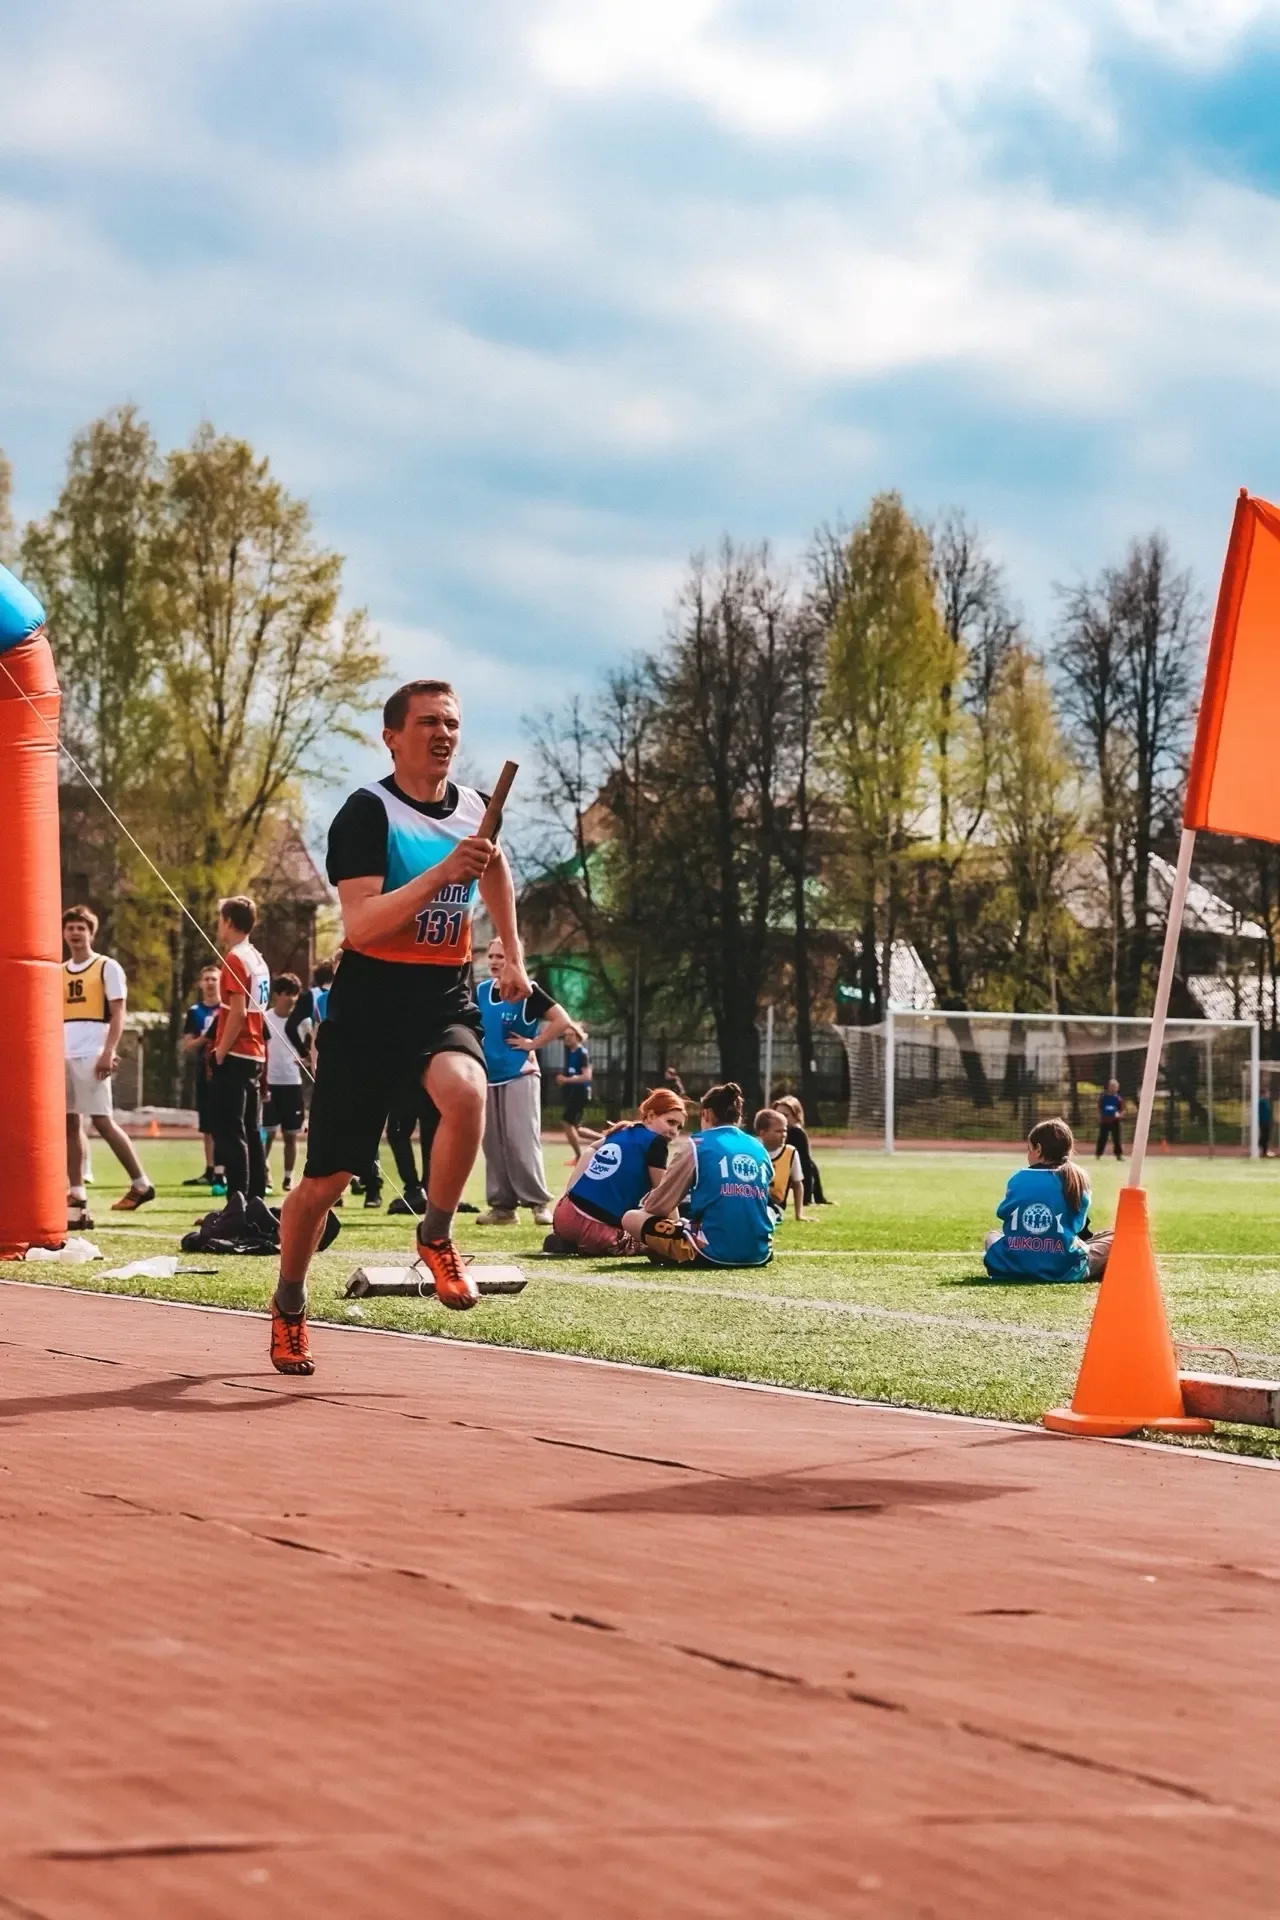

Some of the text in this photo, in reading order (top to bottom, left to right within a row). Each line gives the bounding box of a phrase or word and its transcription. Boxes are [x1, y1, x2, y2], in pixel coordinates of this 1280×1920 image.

[415, 909, 463, 947] 131
[68, 979, 83, 997] 16
[1007, 1236, 1065, 1255] ШКОЛА
